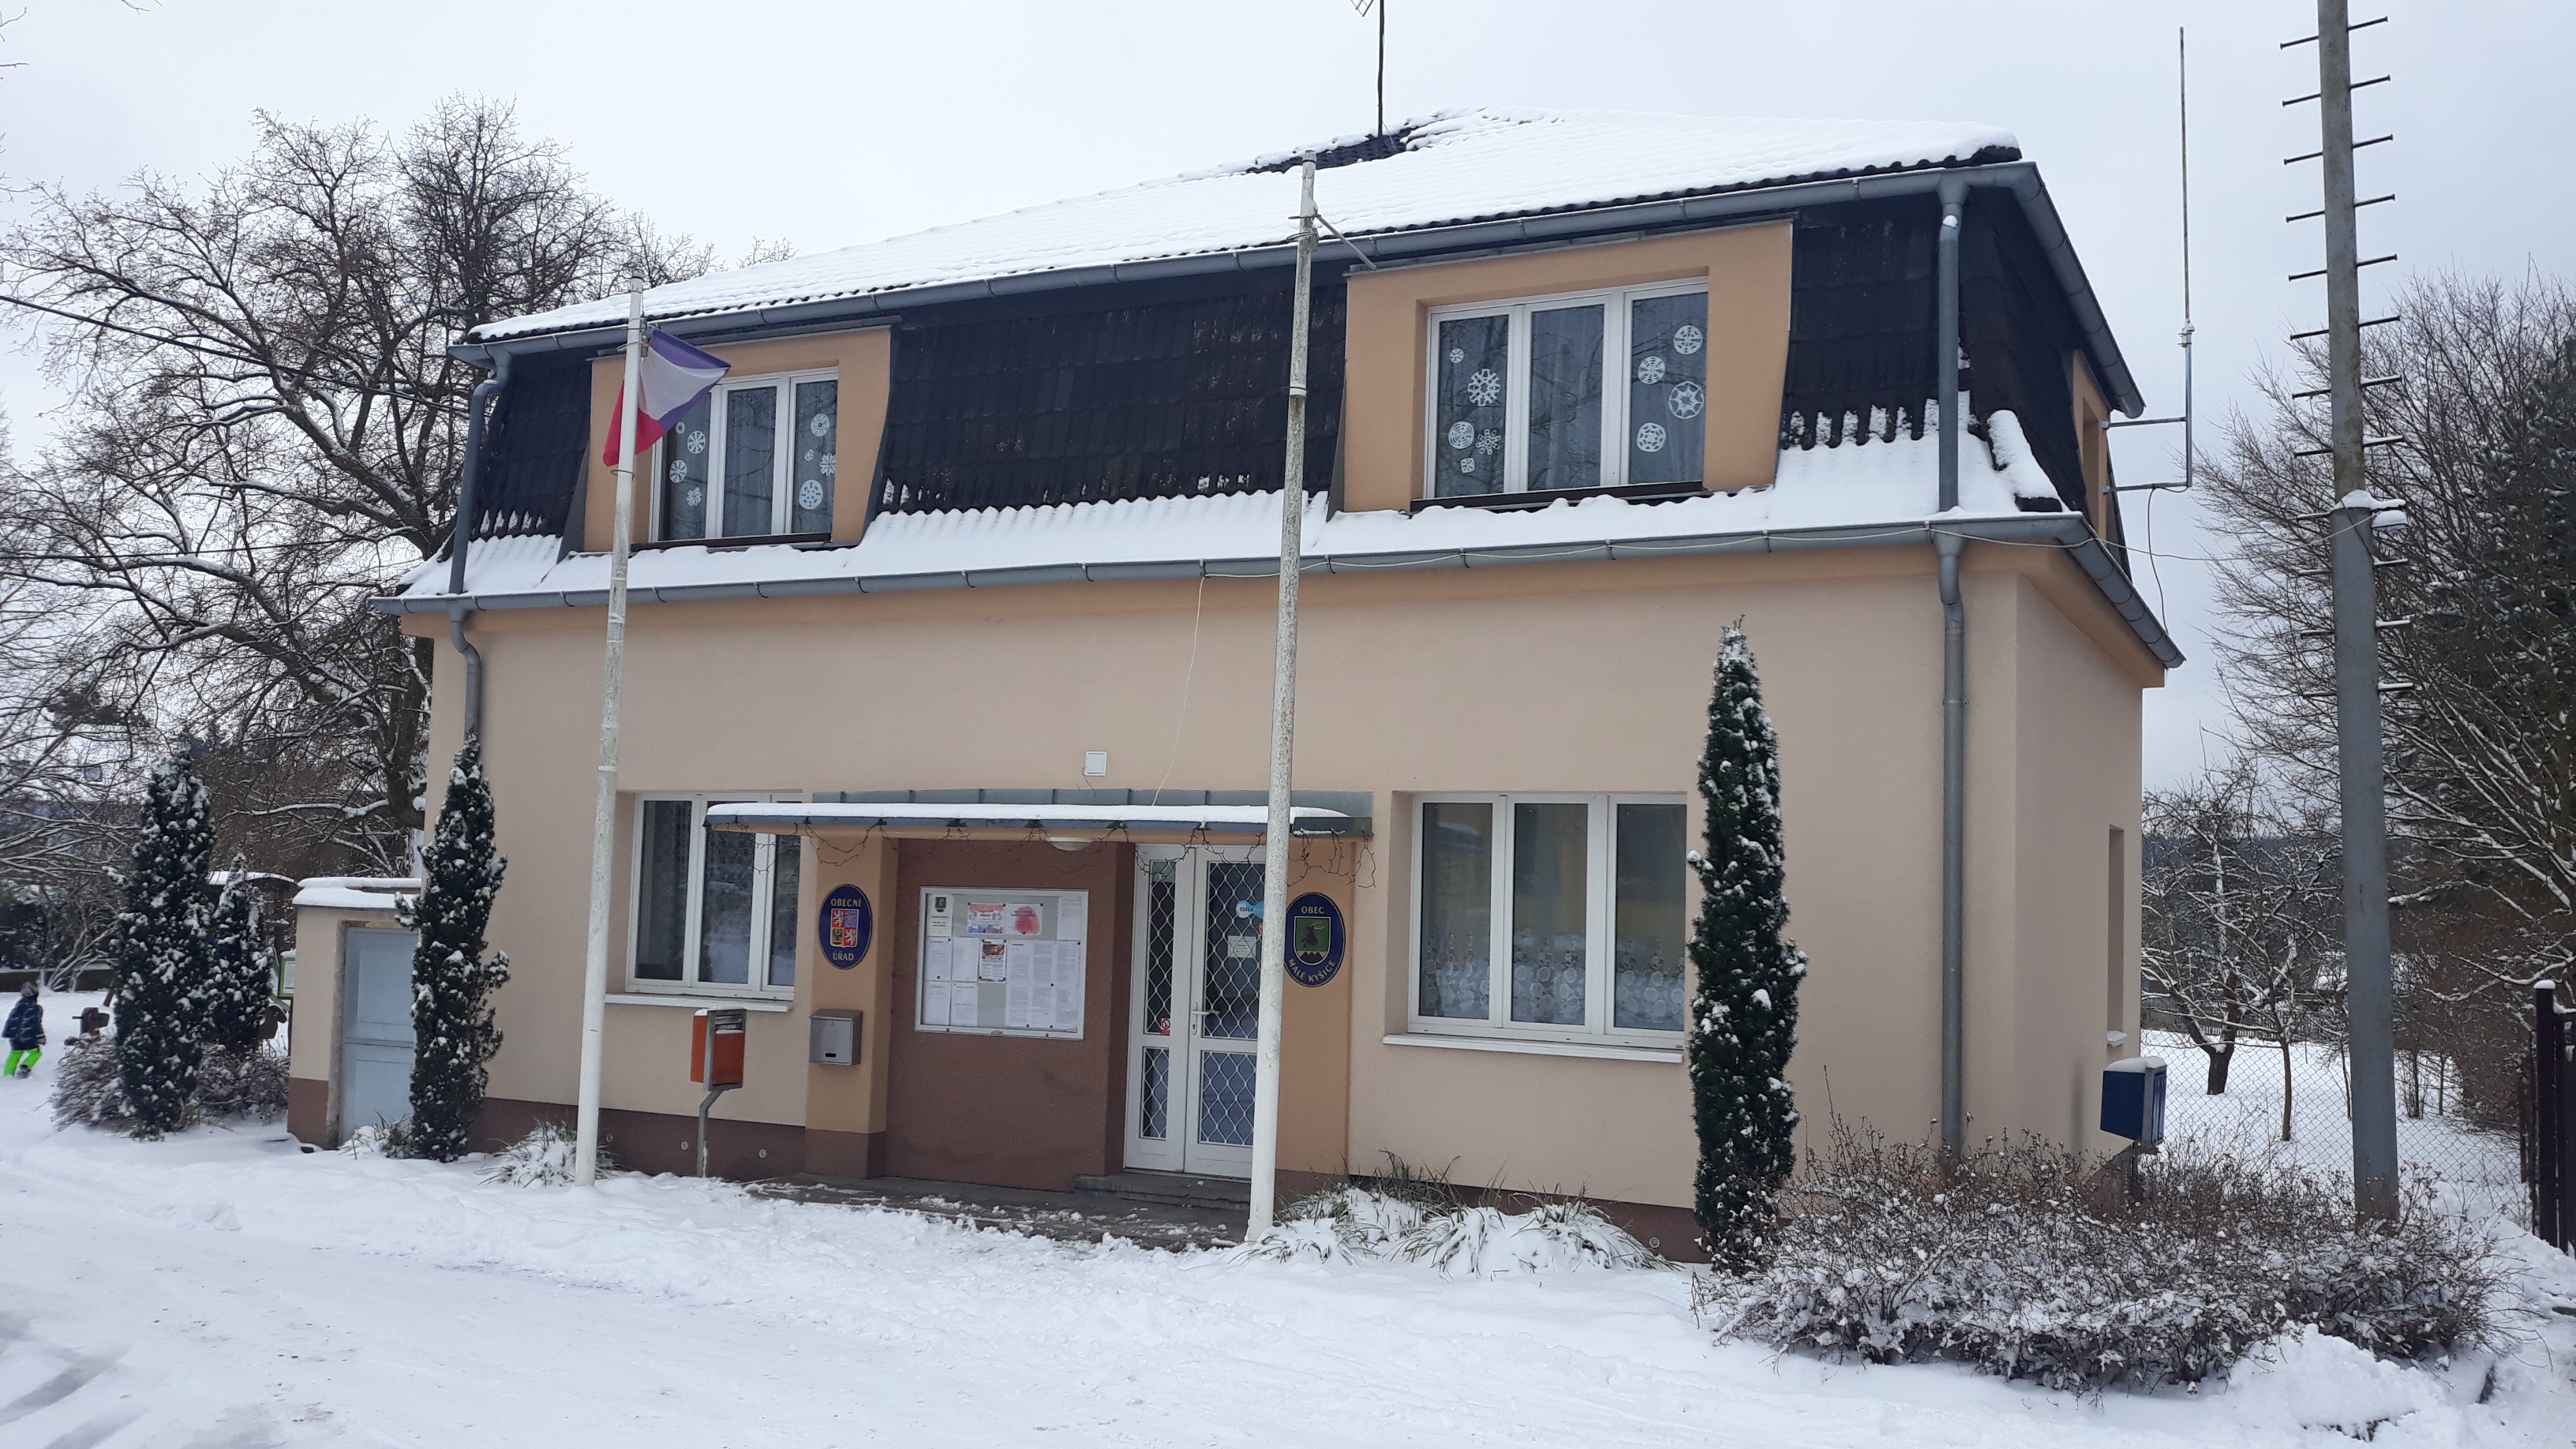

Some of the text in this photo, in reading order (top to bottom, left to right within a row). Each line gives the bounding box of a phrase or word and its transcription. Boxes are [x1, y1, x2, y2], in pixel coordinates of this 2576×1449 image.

[831, 897, 861, 907] OBECNÍ
[833, 950, 854, 961] ÚŘAD
[1288, 958, 1335, 983] MALÉ KYŠICE
